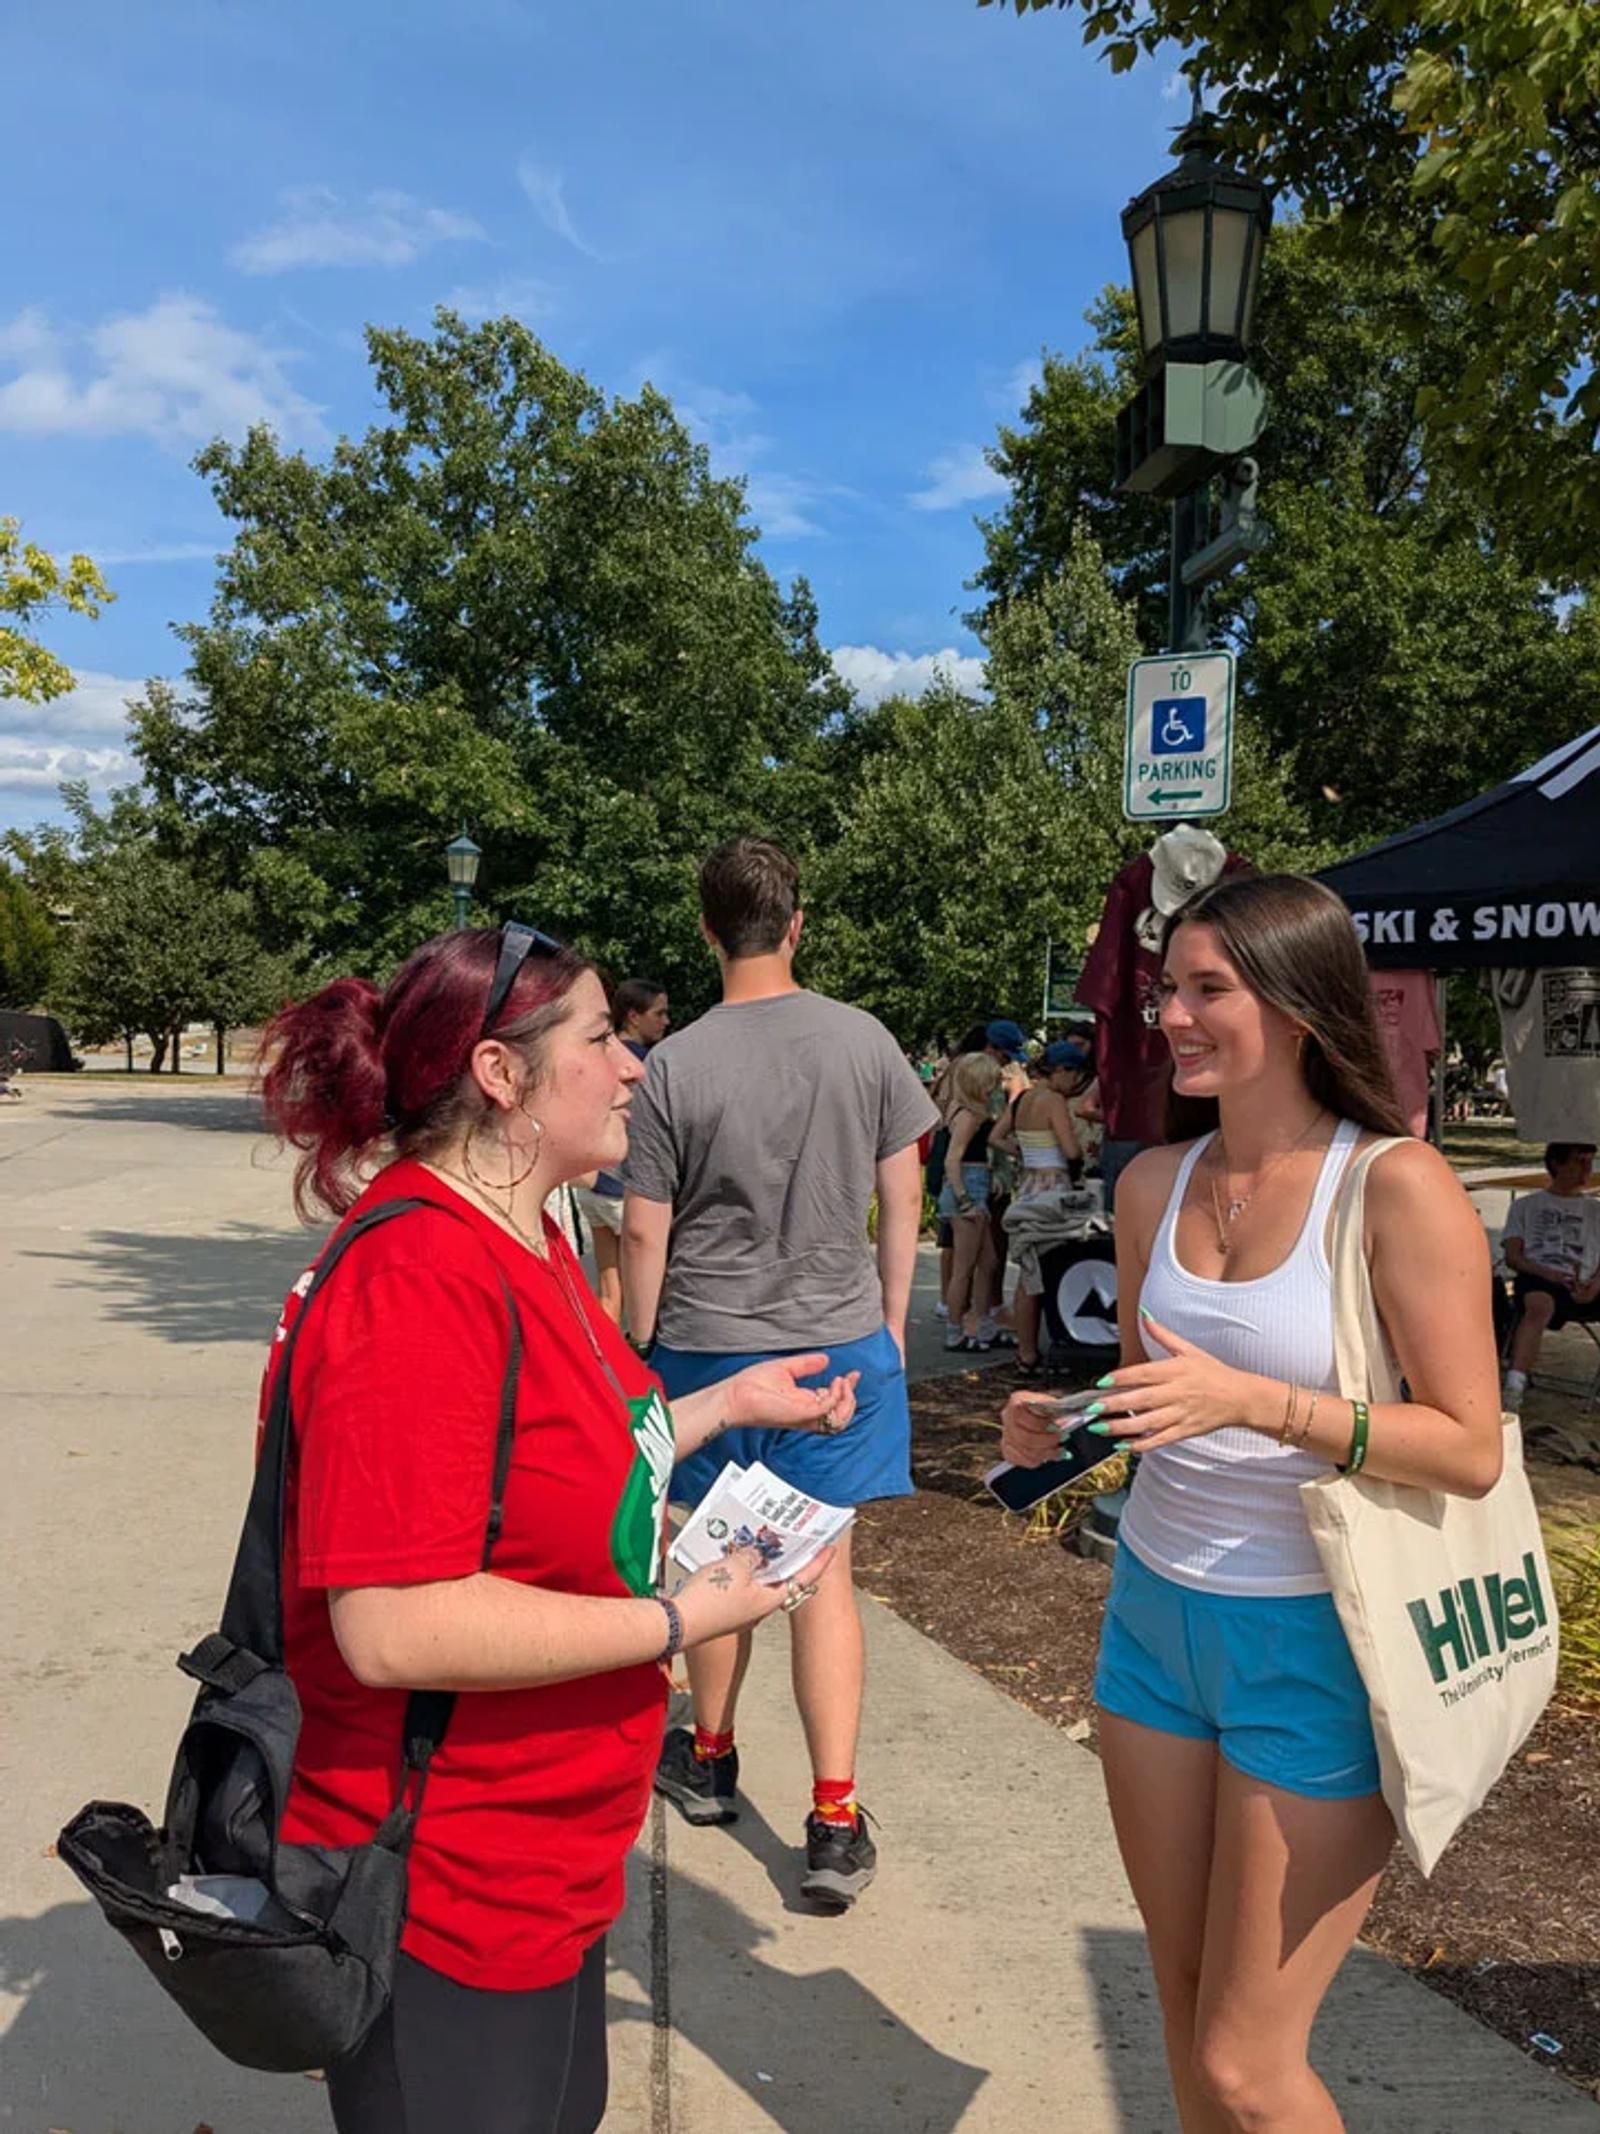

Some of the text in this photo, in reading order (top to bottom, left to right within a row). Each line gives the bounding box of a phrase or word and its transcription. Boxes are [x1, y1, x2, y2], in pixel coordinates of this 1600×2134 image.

[1170, 671, 1191, 691] TO
[1138, 759, 1217, 782] PARKING
[1351, 901, 1600, 943] SKI & SNOW
